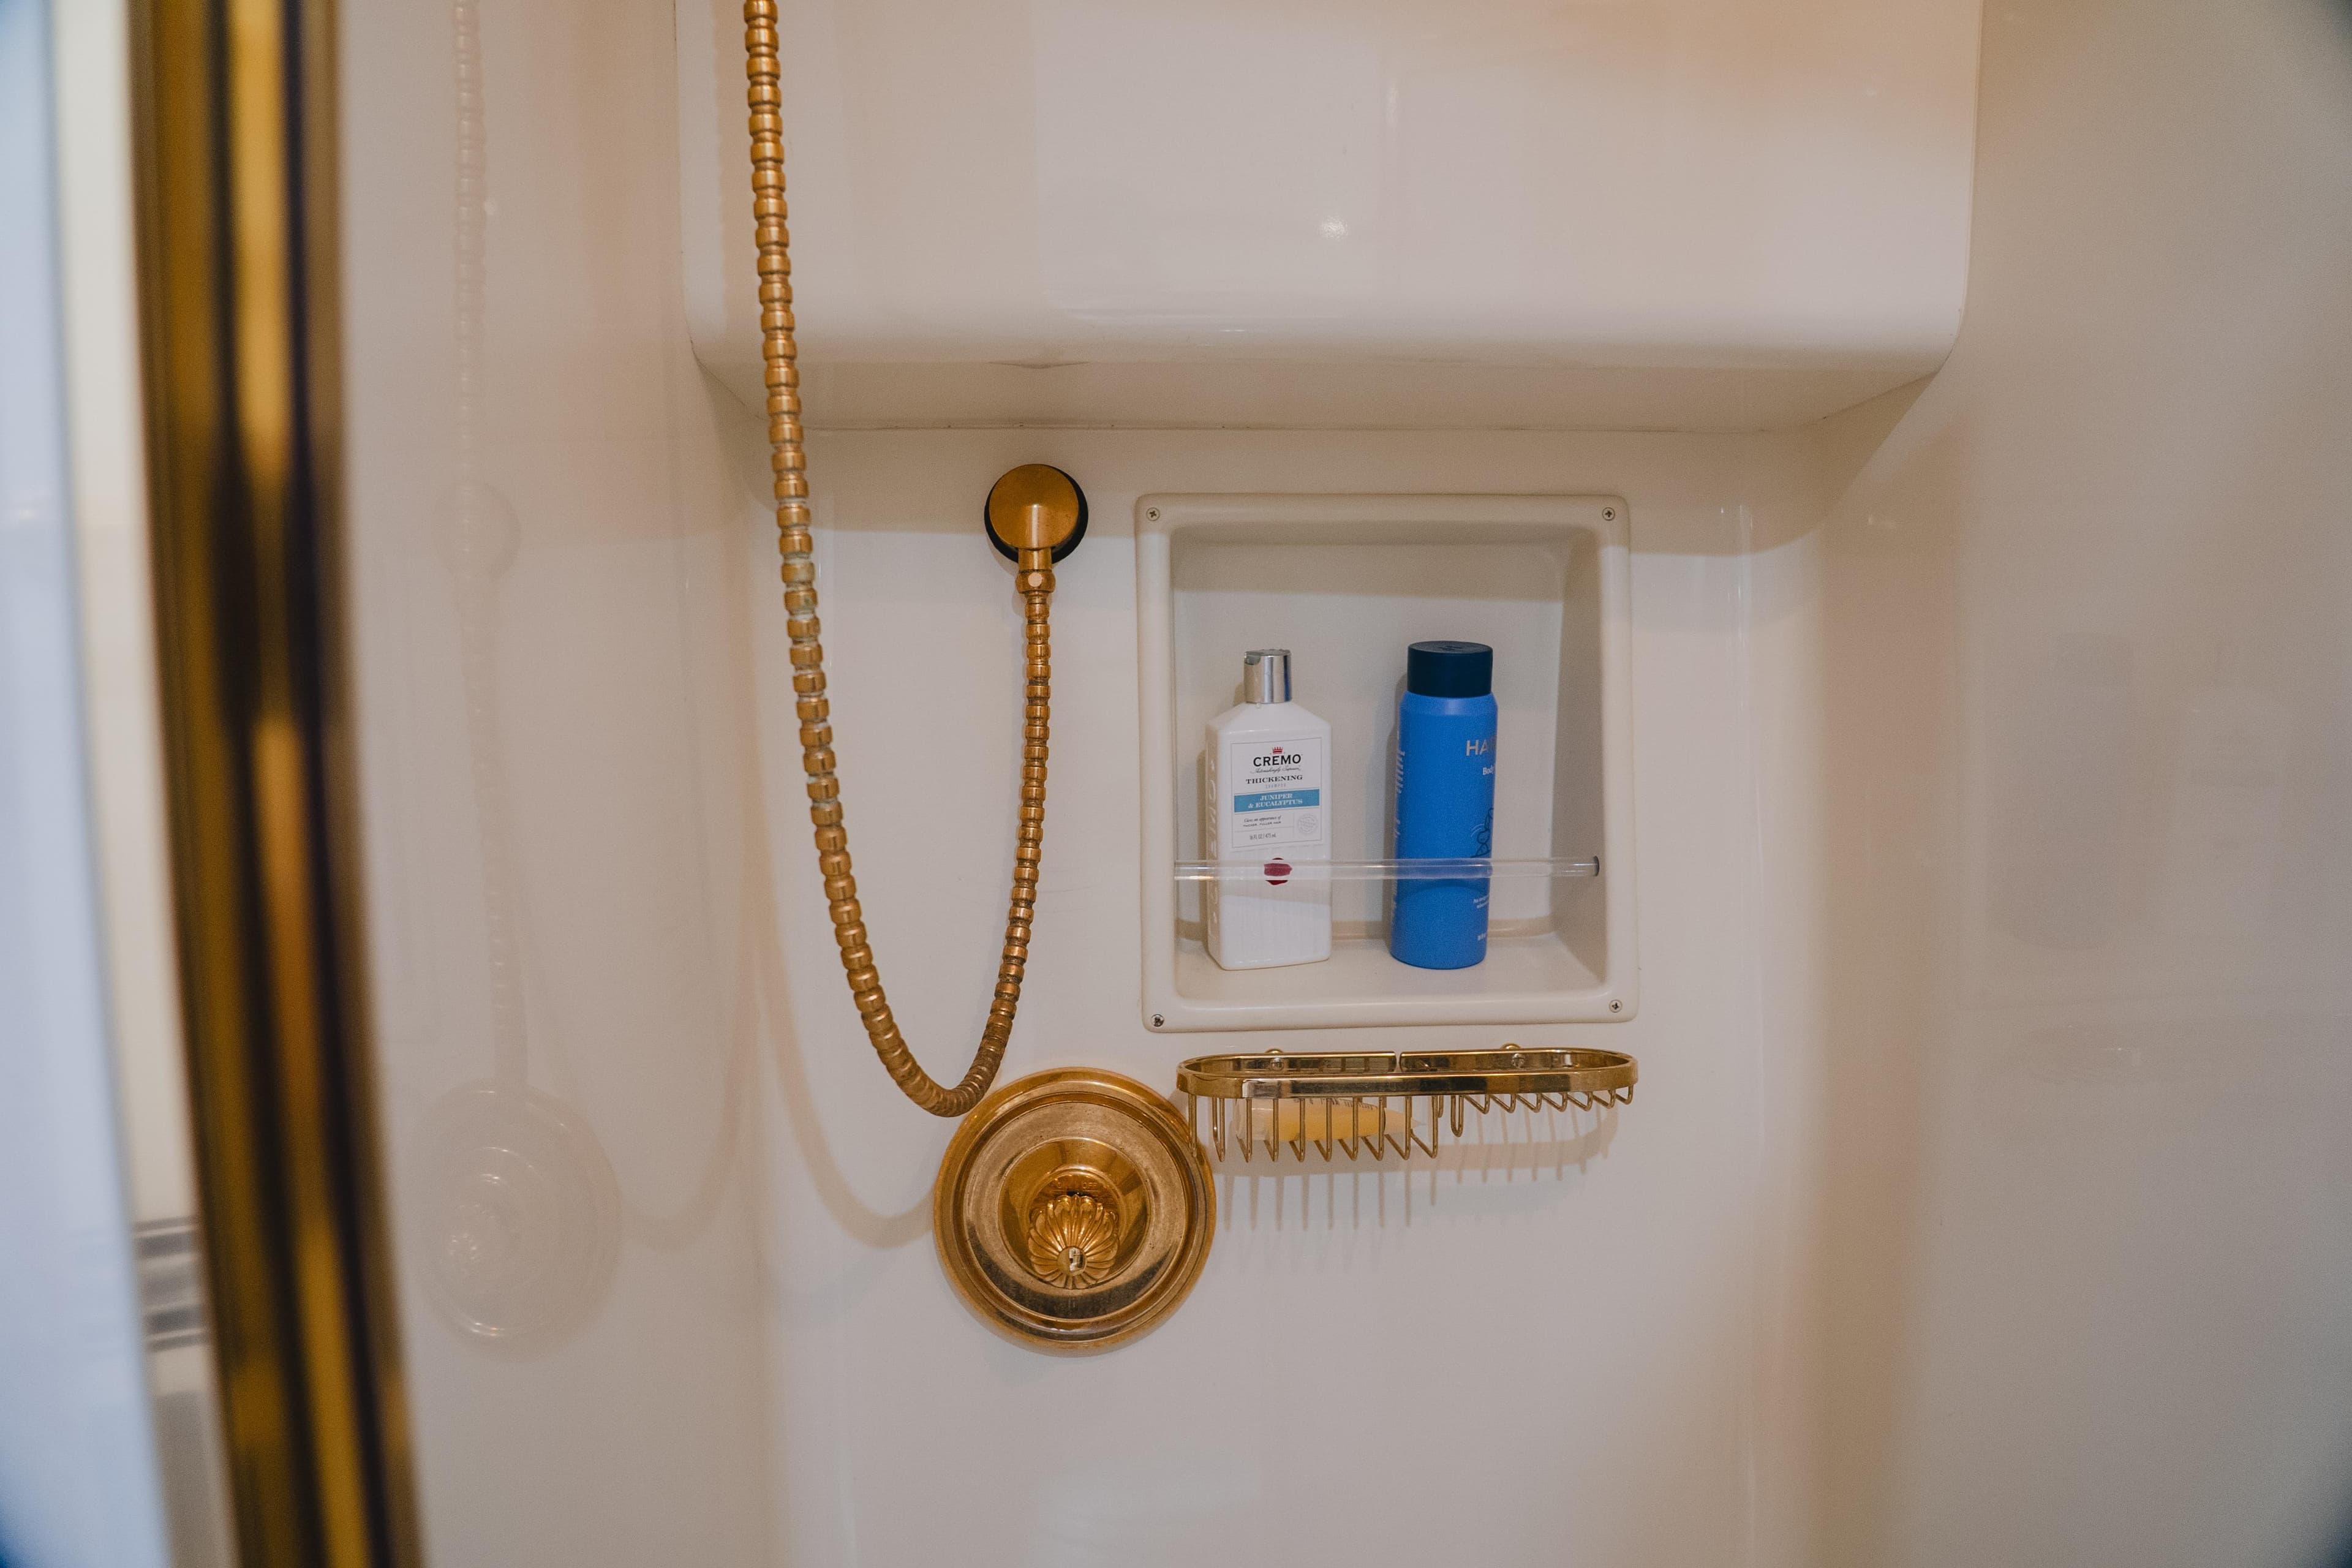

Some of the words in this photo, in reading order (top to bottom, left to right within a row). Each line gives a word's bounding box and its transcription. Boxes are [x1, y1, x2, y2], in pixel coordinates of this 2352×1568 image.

[1253, 754, 1301, 767] CREMO
[1245, 775, 1303, 784] THICKENING
[1256, 799, 1303, 808] EUCALYPTUS
